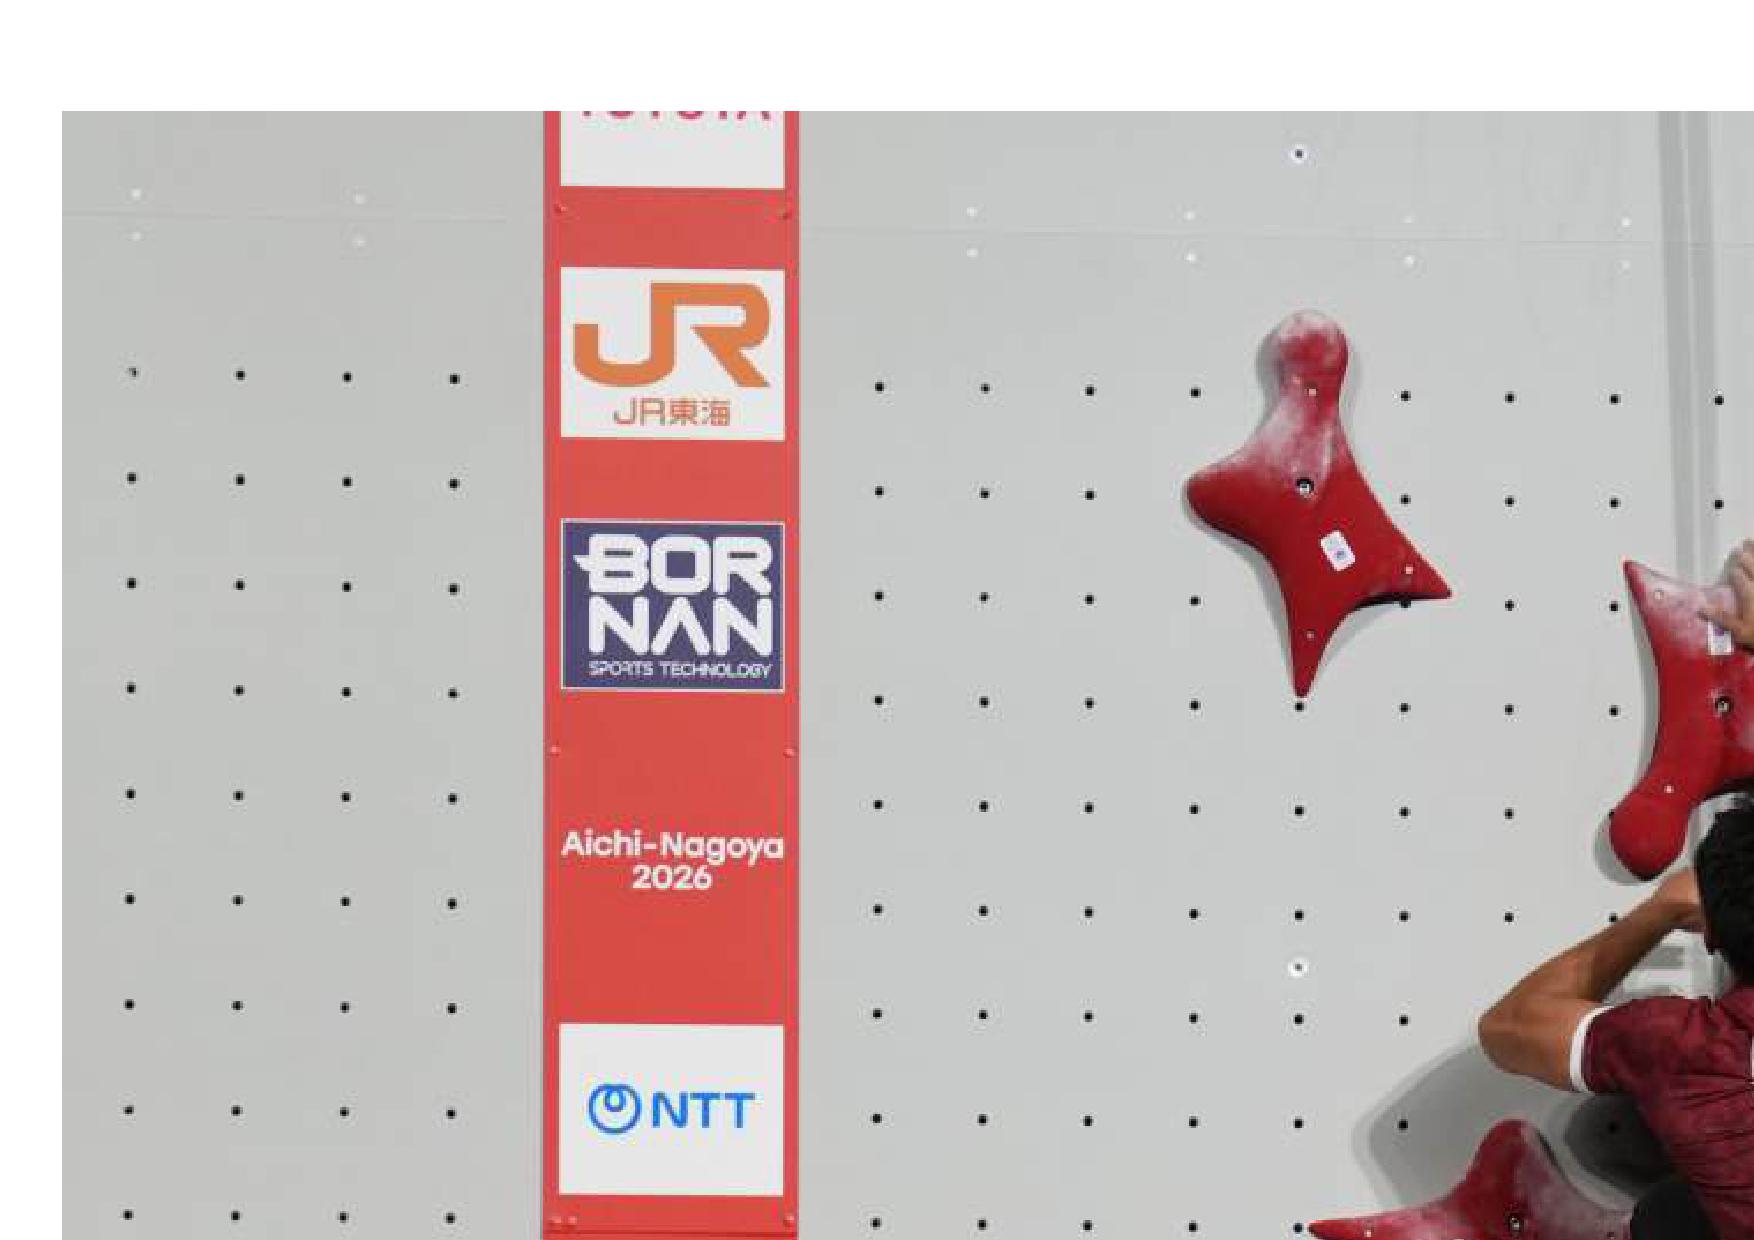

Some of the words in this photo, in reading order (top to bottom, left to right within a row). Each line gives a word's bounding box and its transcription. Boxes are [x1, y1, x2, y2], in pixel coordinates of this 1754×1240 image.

[572, 282, 770, 388] JR
[613, 397, 731, 427] JR東海
[588, 660, 654, 677] SPORTS
[659, 661, 772, 680] TECHNOLOGY
[561, 829, 784, 867] Aichi-Nagoya
[632, 864, 713, 889] 2026
[652, 1091, 756, 1128] NTT
